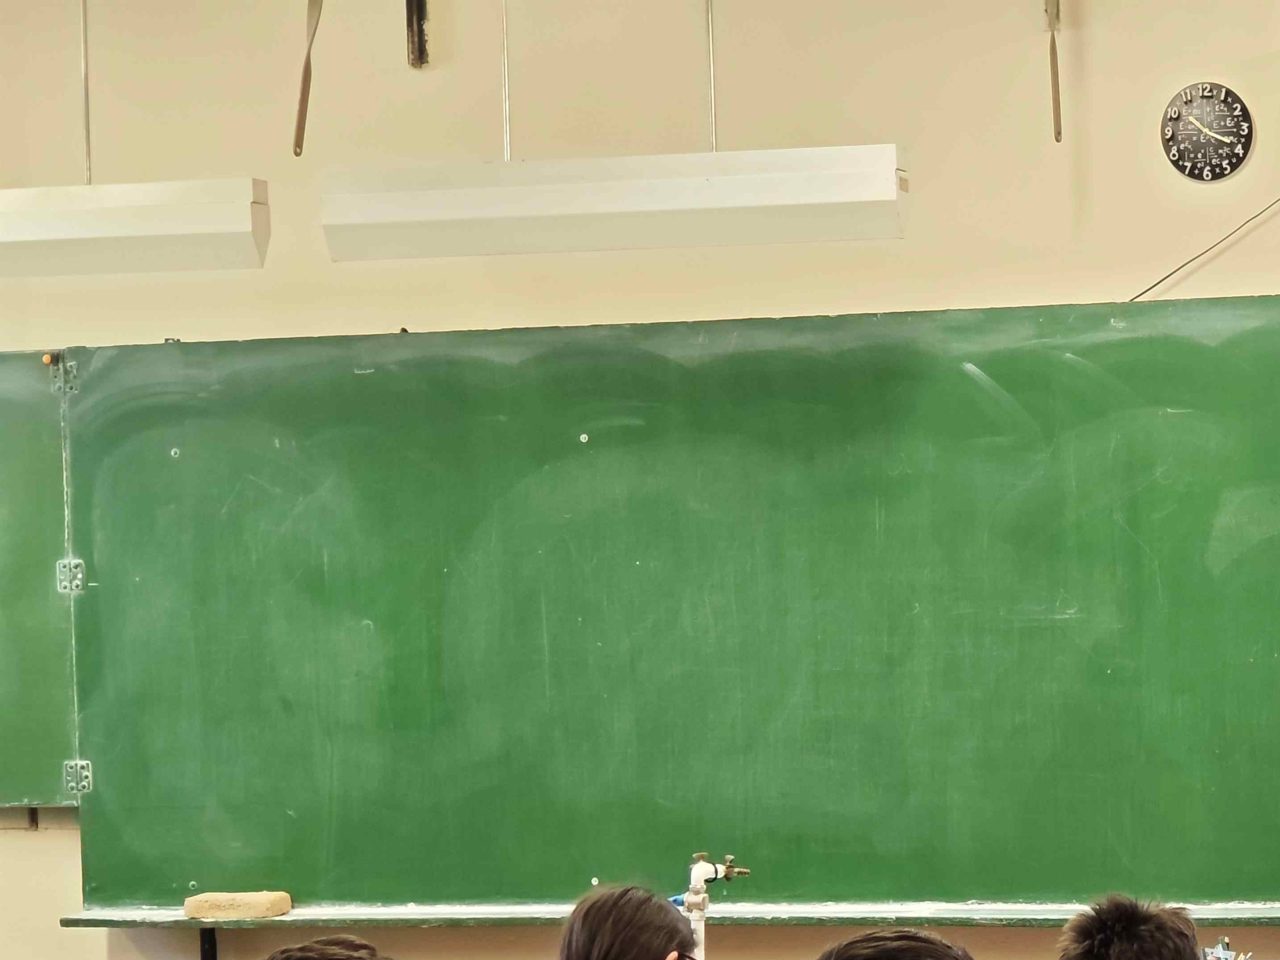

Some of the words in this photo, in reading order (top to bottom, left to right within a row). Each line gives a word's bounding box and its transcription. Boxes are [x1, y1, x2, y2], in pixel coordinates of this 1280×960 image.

[1181, 89, 1191, 102] 11
[1198, 84, 1212, 96] 12
[1220, 88, 1226, 100] 1
[1167, 107, 1179, 119] 10
[1232, 104, 1242, 116] 2
[1164, 127, 1173, 139] 9
[1240, 122, 1250, 135] 3
[1169, 145, 1178, 160] 8
[1234, 144, 1244, 157] 4
[1183, 162, 1192, 175] 7
[1203, 166, 1212, 180] 6
[1221, 159, 1231, 174] 5
